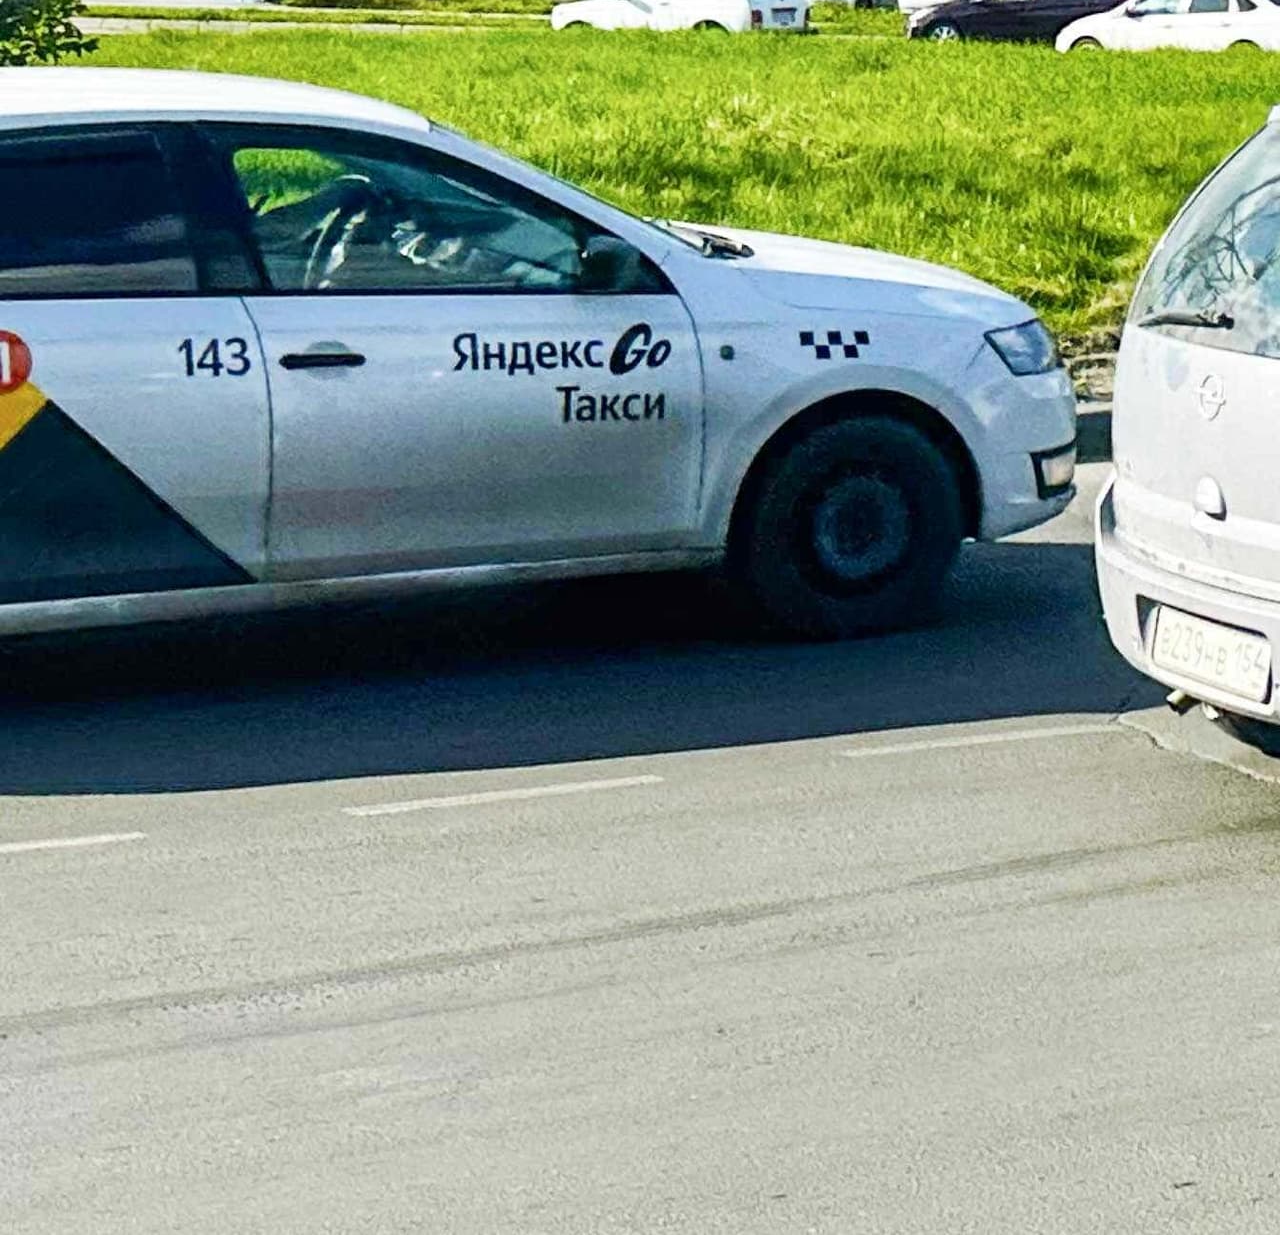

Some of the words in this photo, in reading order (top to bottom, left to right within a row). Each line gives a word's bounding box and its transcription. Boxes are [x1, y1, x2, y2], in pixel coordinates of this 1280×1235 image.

[177, 337, 252, 377] 143
[452, 333, 604, 376] Яндекс
[608, 322, 672, 375] Go
[555, 385, 667, 423] Такси
